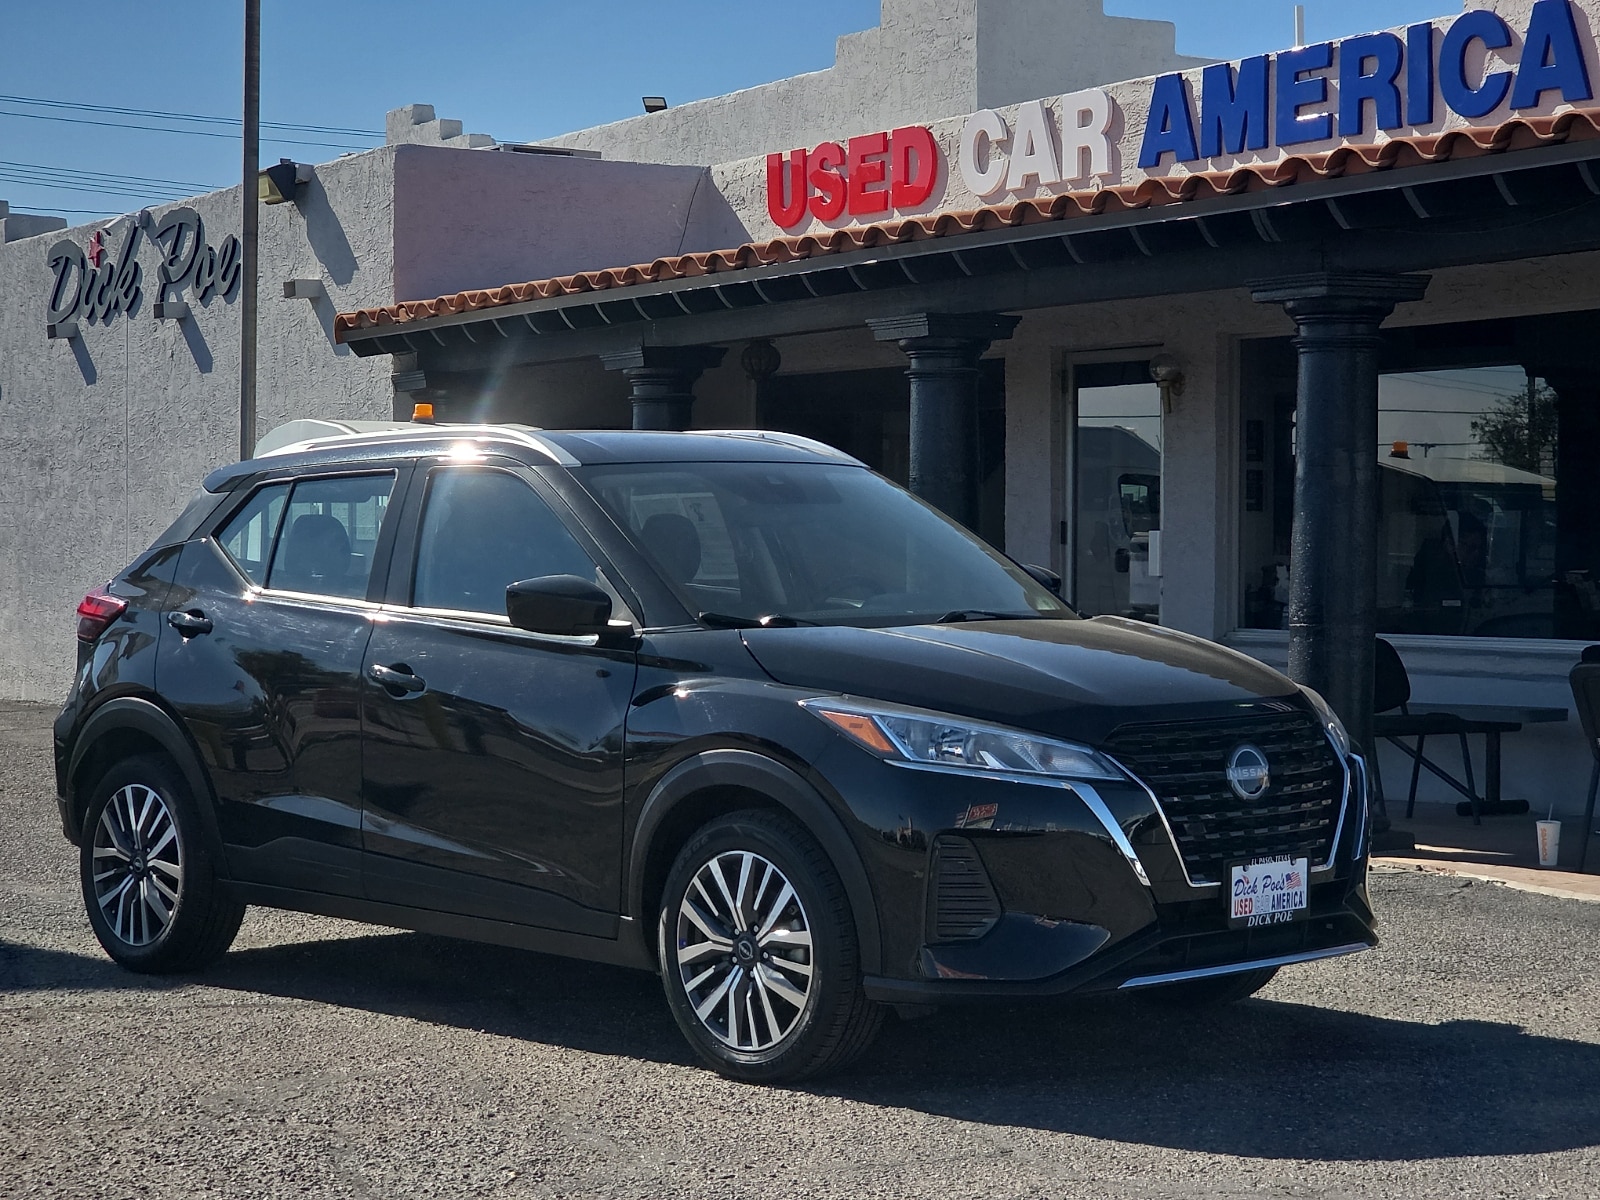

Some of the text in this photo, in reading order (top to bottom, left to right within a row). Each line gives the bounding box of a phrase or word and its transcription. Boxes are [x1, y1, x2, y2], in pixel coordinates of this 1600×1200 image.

[767, 0, 1593, 228] USED CAR AMERICA
[47, 206, 241, 325] Dick Poe
[1229, 767, 1268, 778] NISSAN
[1234, 876, 1258, 897] Dick
[1234, 897, 1253, 916] USED
[1271, 891, 1303, 911] AMERICA
[1247, 911, 1293, 927] DICK POE
